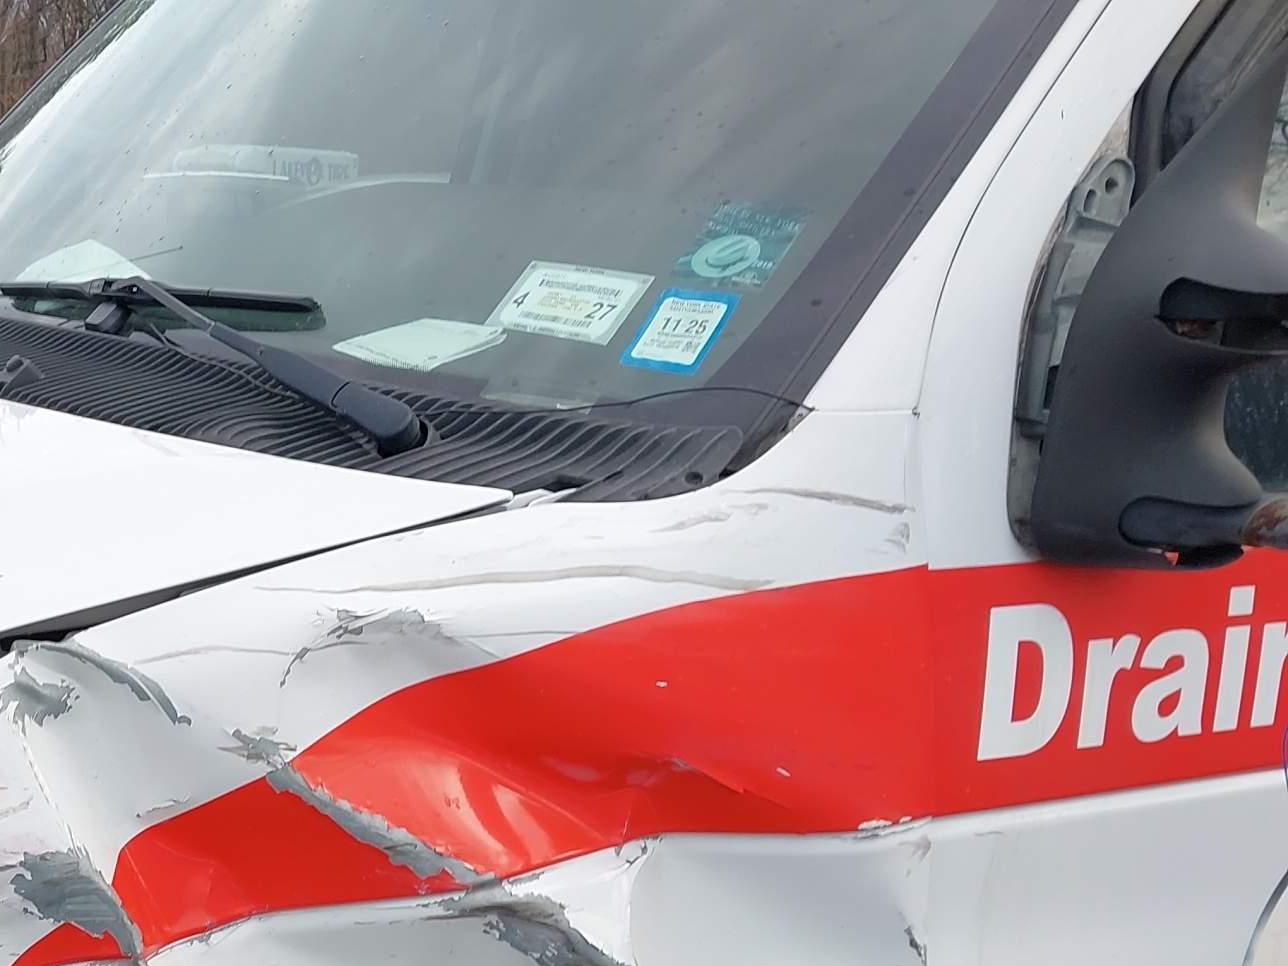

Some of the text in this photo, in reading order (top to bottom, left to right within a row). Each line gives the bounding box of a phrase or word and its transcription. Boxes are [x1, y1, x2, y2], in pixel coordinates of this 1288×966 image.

[513, 291, 530, 308] 4
[584, 302, 617, 320] 27
[662, 316, 710, 334] 11 25
